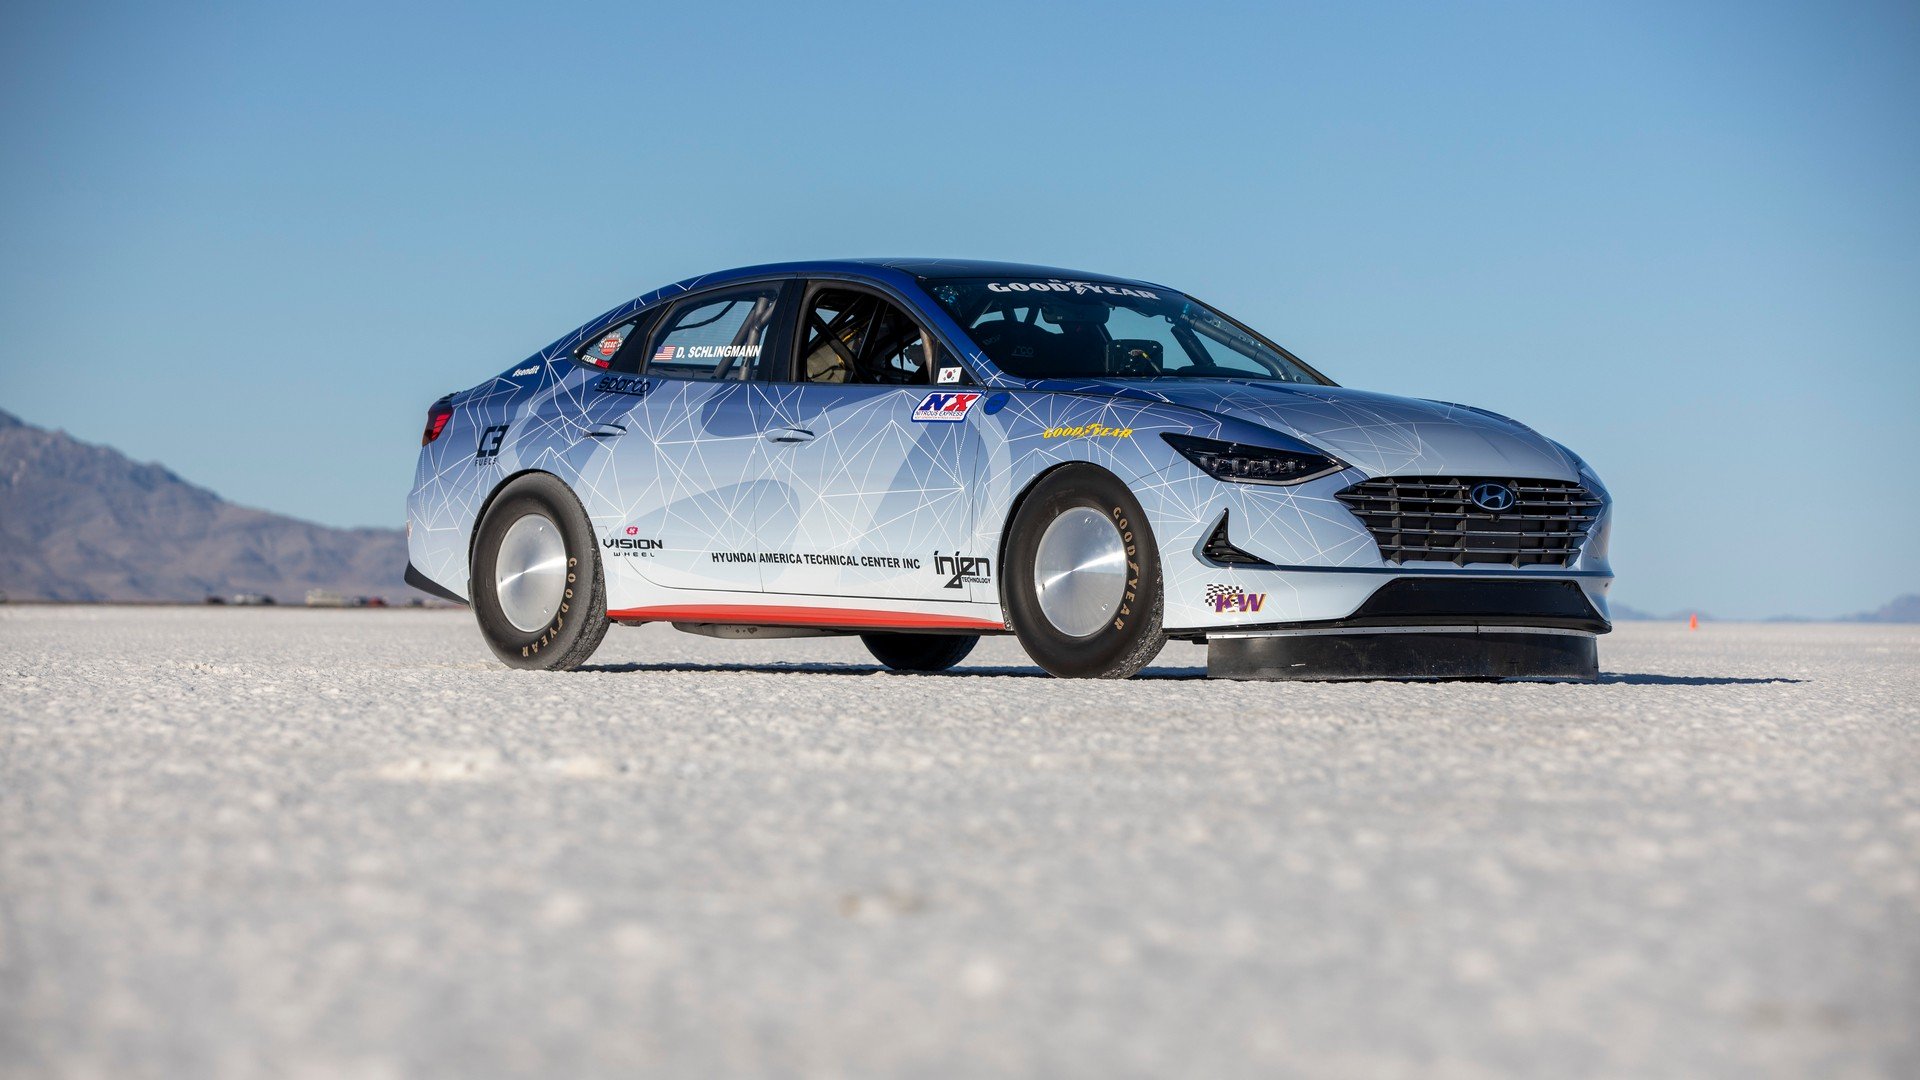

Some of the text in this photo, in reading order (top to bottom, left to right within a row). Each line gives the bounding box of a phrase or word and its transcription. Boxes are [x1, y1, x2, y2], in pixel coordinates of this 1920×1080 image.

[676, 345, 763, 359] D. SCHLINGMANN
[512, 365, 540, 377] #sendit
[598, 377, 651, 394] sparco
[919, 394, 979, 411] NX
[602, 539, 664, 549] VISION
[712, 552, 921, 569] HYUNDAI AMERICA TECHNICAL CENTER INC
[934, 550, 991, 589] injen
[961, 576, 991, 584] TECHNOLOGY
